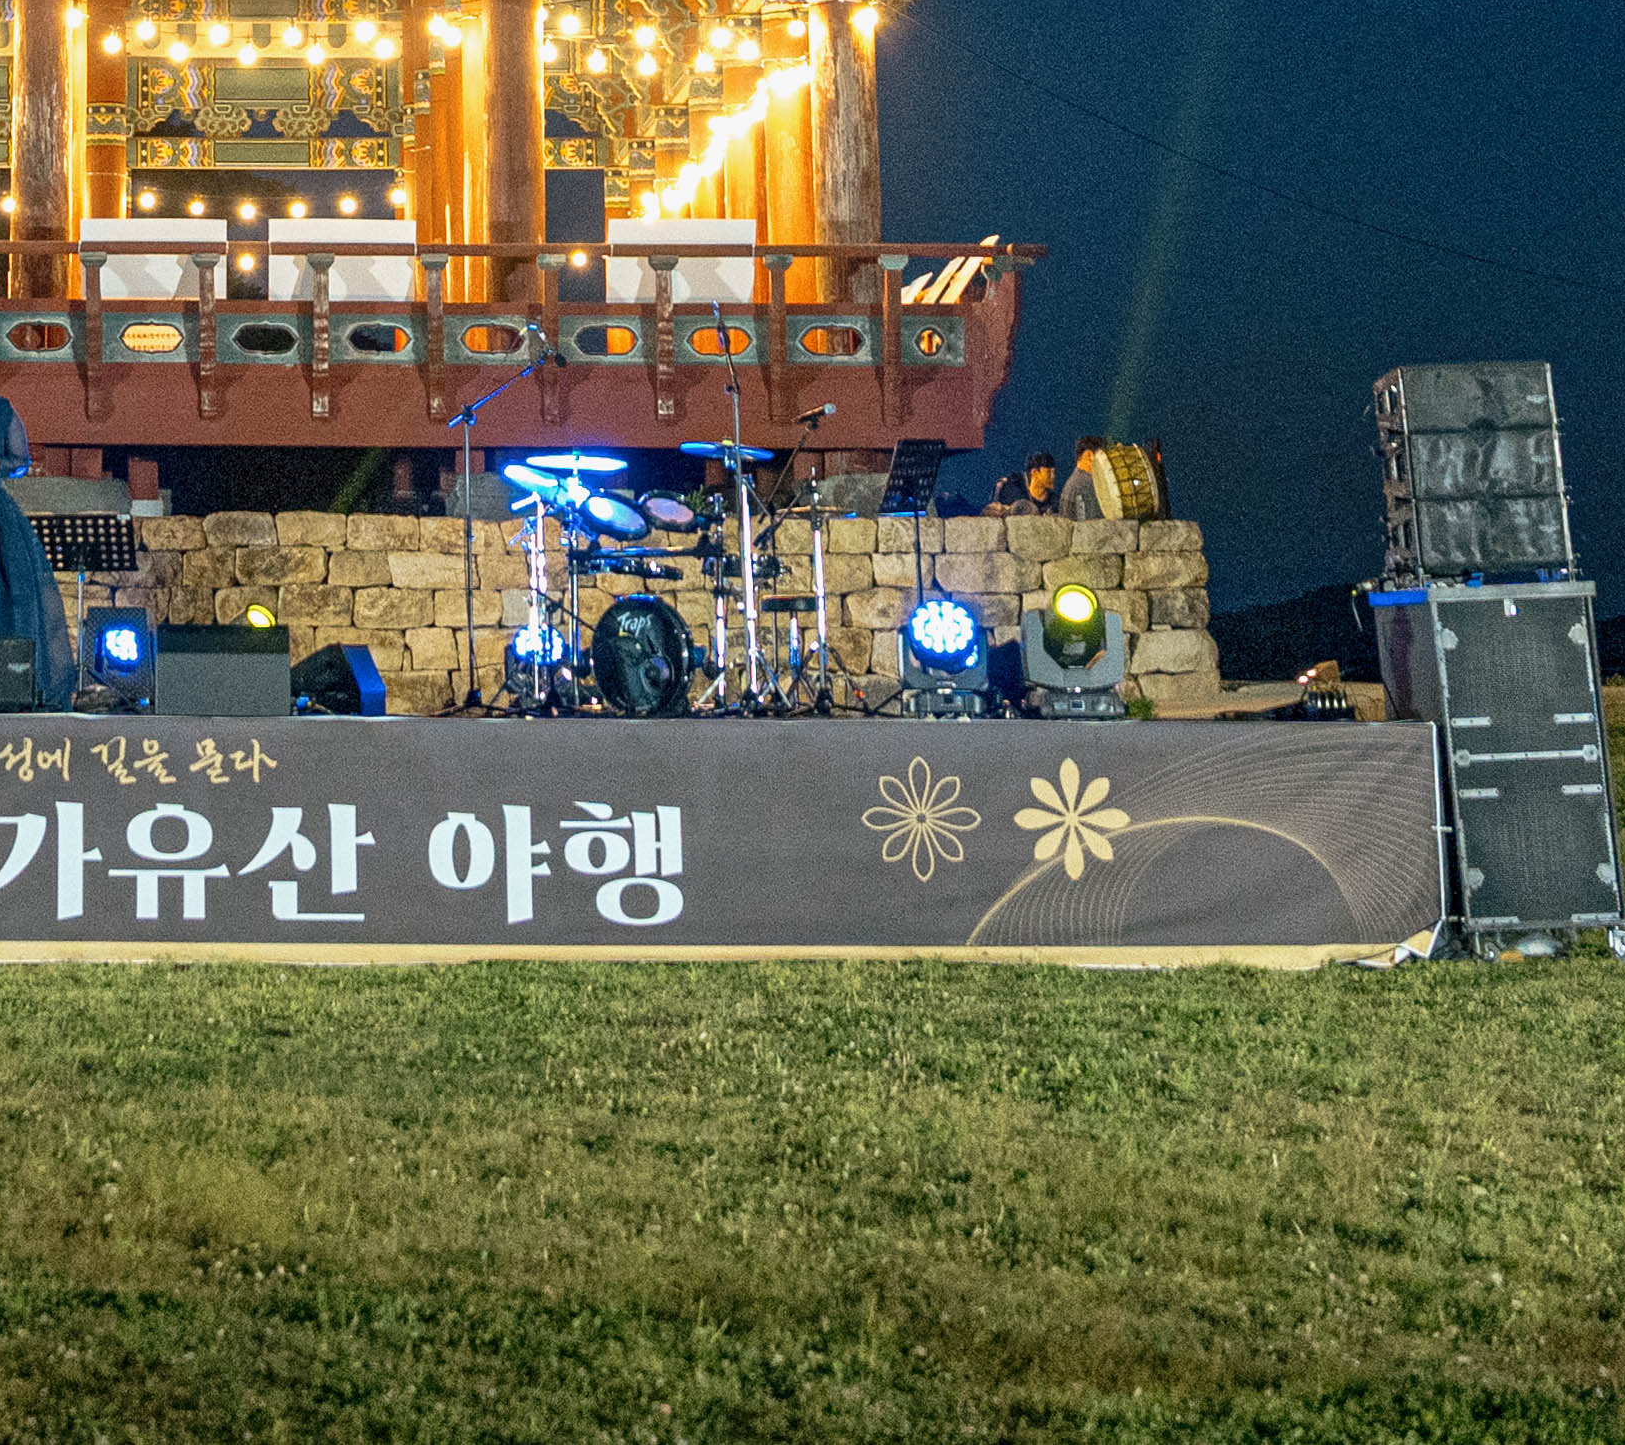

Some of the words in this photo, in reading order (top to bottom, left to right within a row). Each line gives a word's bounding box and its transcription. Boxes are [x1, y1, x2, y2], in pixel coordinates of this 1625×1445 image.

[617, 611, 653, 638] Traps
[89, 735, 178, 785] 길을
[427, 800, 685, 927] 야행
